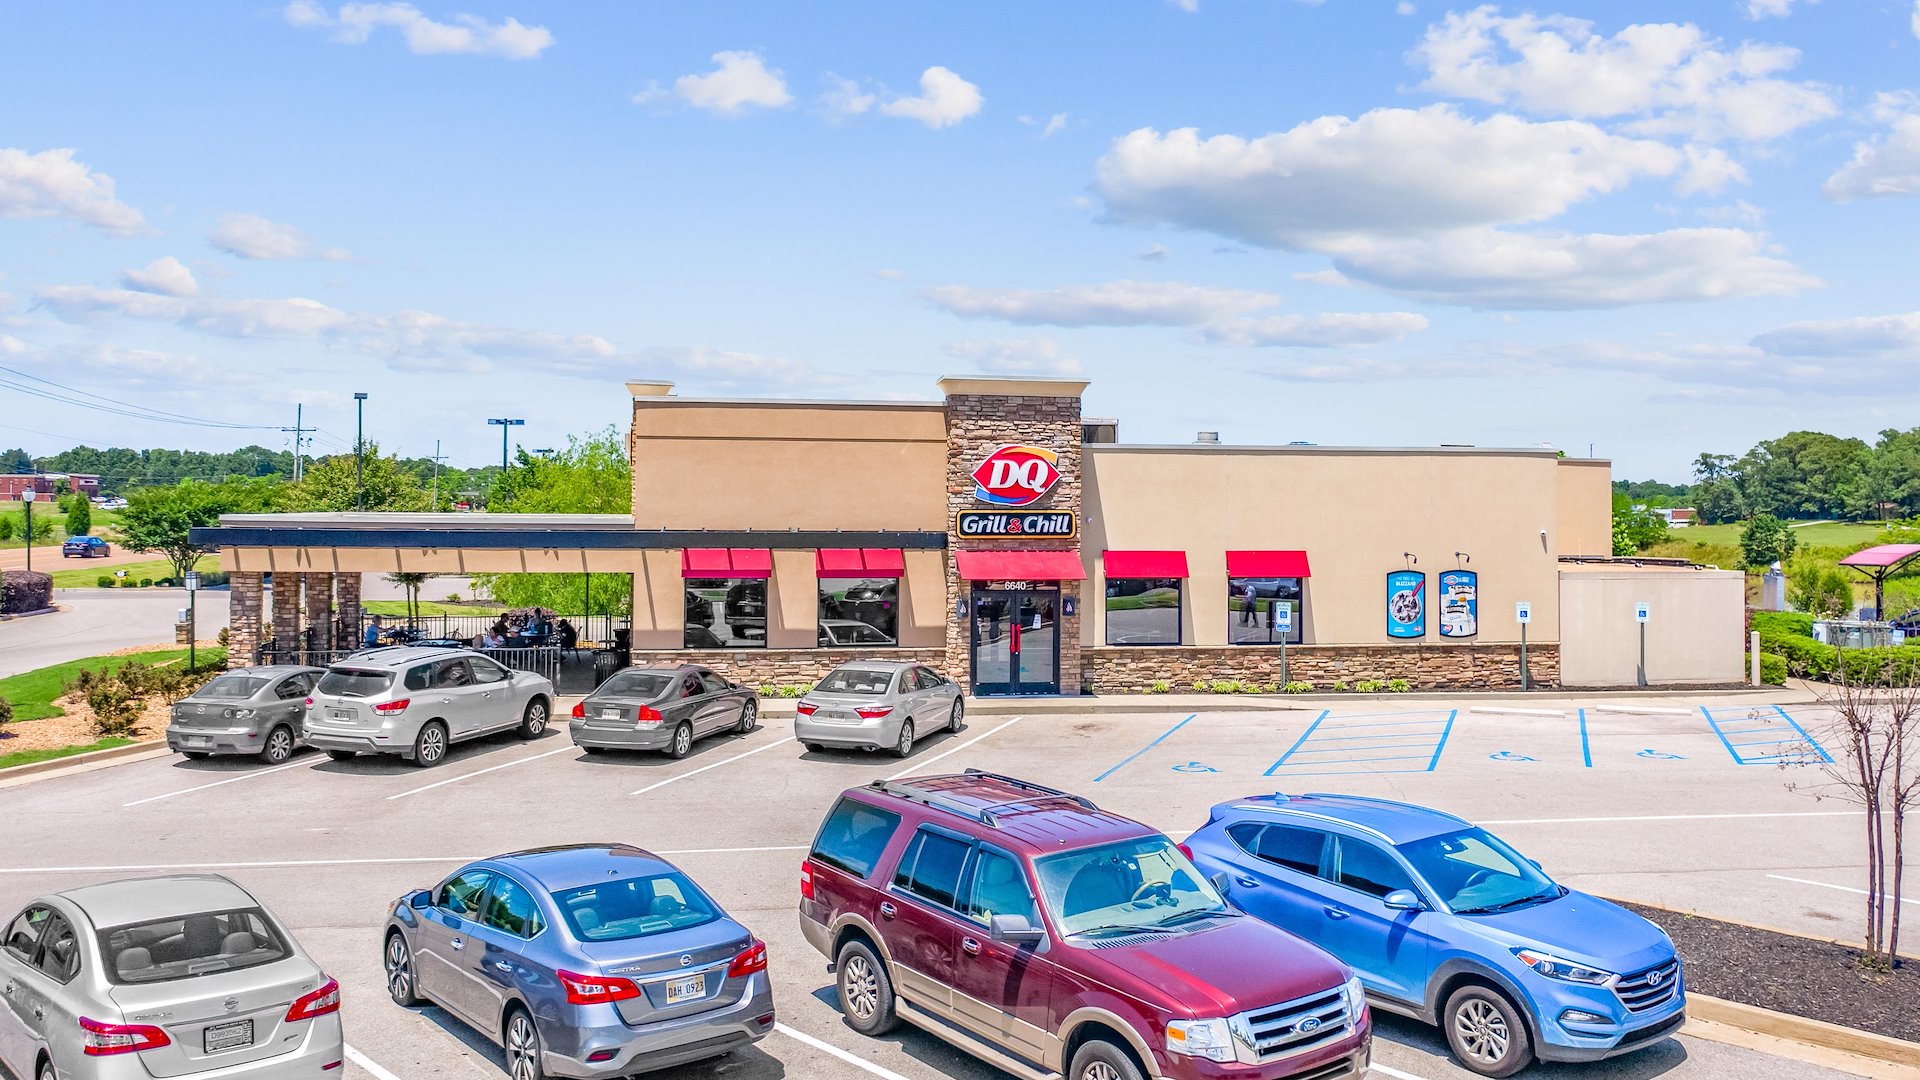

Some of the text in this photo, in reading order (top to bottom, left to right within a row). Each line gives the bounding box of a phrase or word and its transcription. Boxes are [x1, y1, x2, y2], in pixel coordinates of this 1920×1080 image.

[987, 459, 1048, 493] DQ
[1004, 581, 1026, 591] 6640
[668, 985, 683, 998] DAH
[685, 981, 704, 994] 0923
